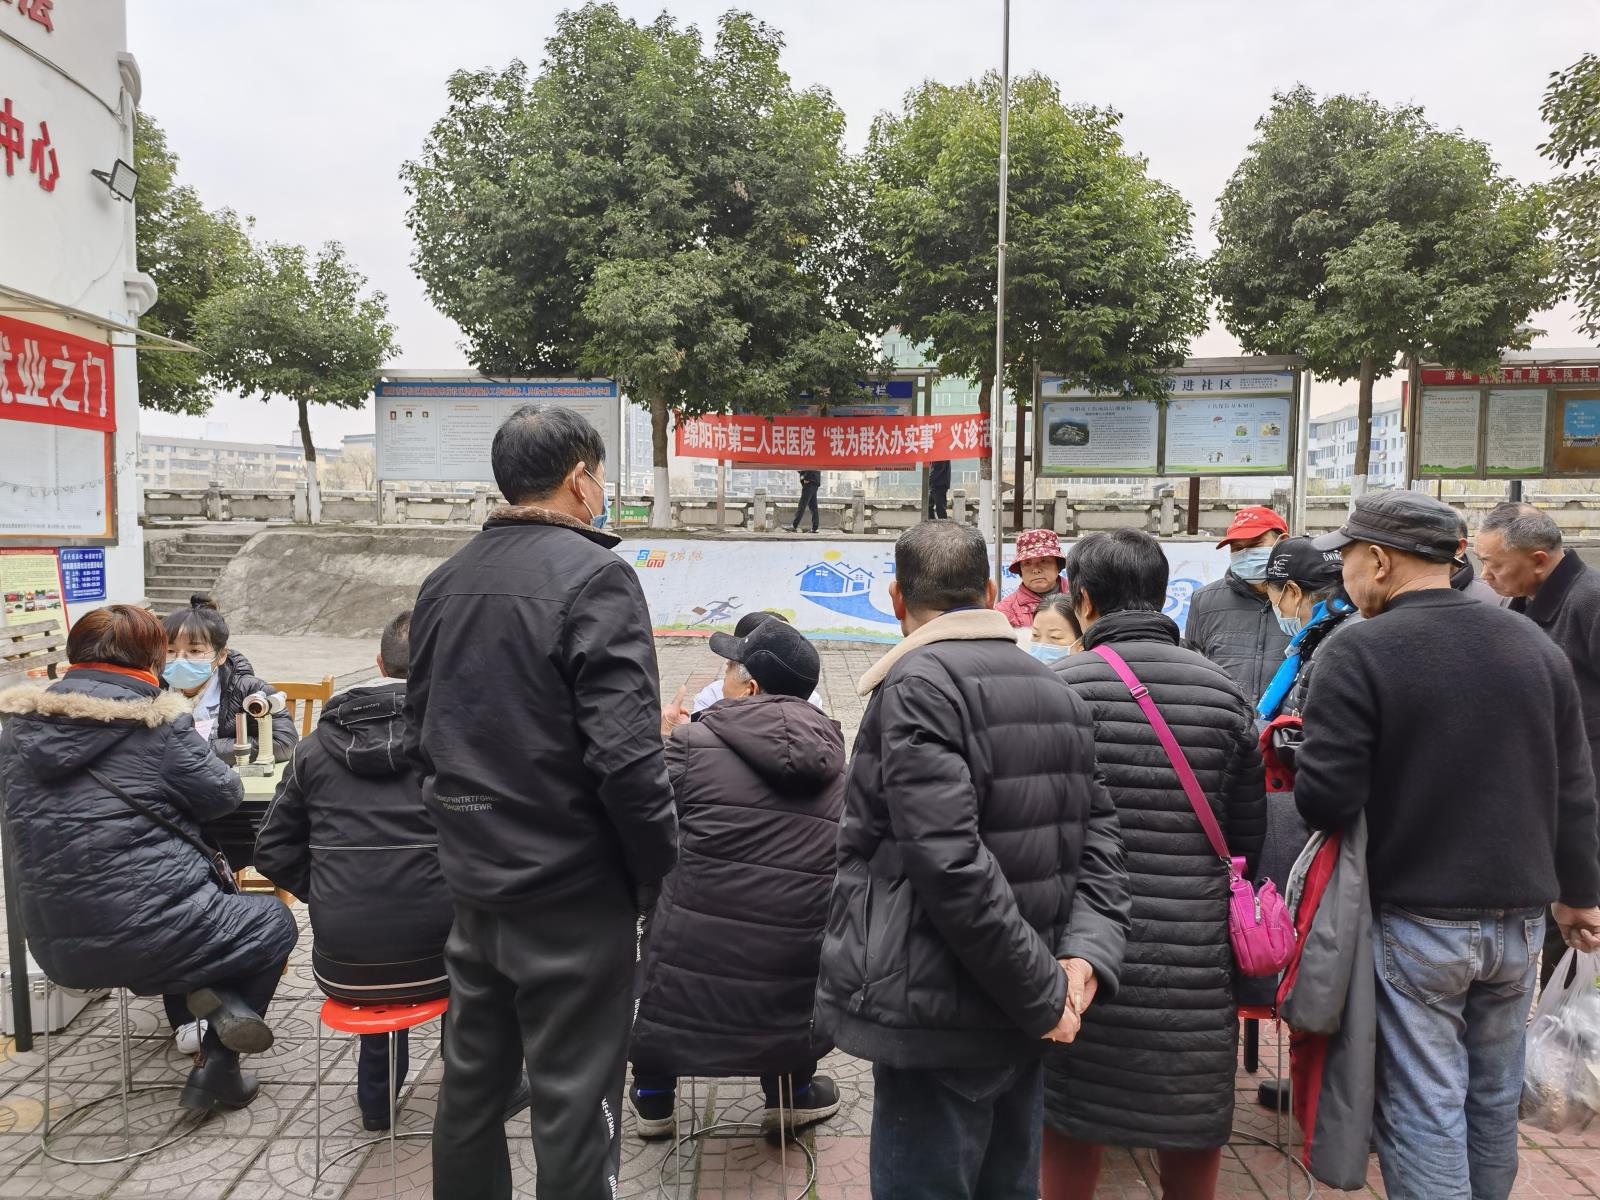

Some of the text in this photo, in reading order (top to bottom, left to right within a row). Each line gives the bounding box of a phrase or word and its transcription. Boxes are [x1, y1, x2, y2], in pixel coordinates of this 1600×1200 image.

[0, 98, 60, 192] 中心
[683, 419, 816, 457] 绵阳市第三人民医院
